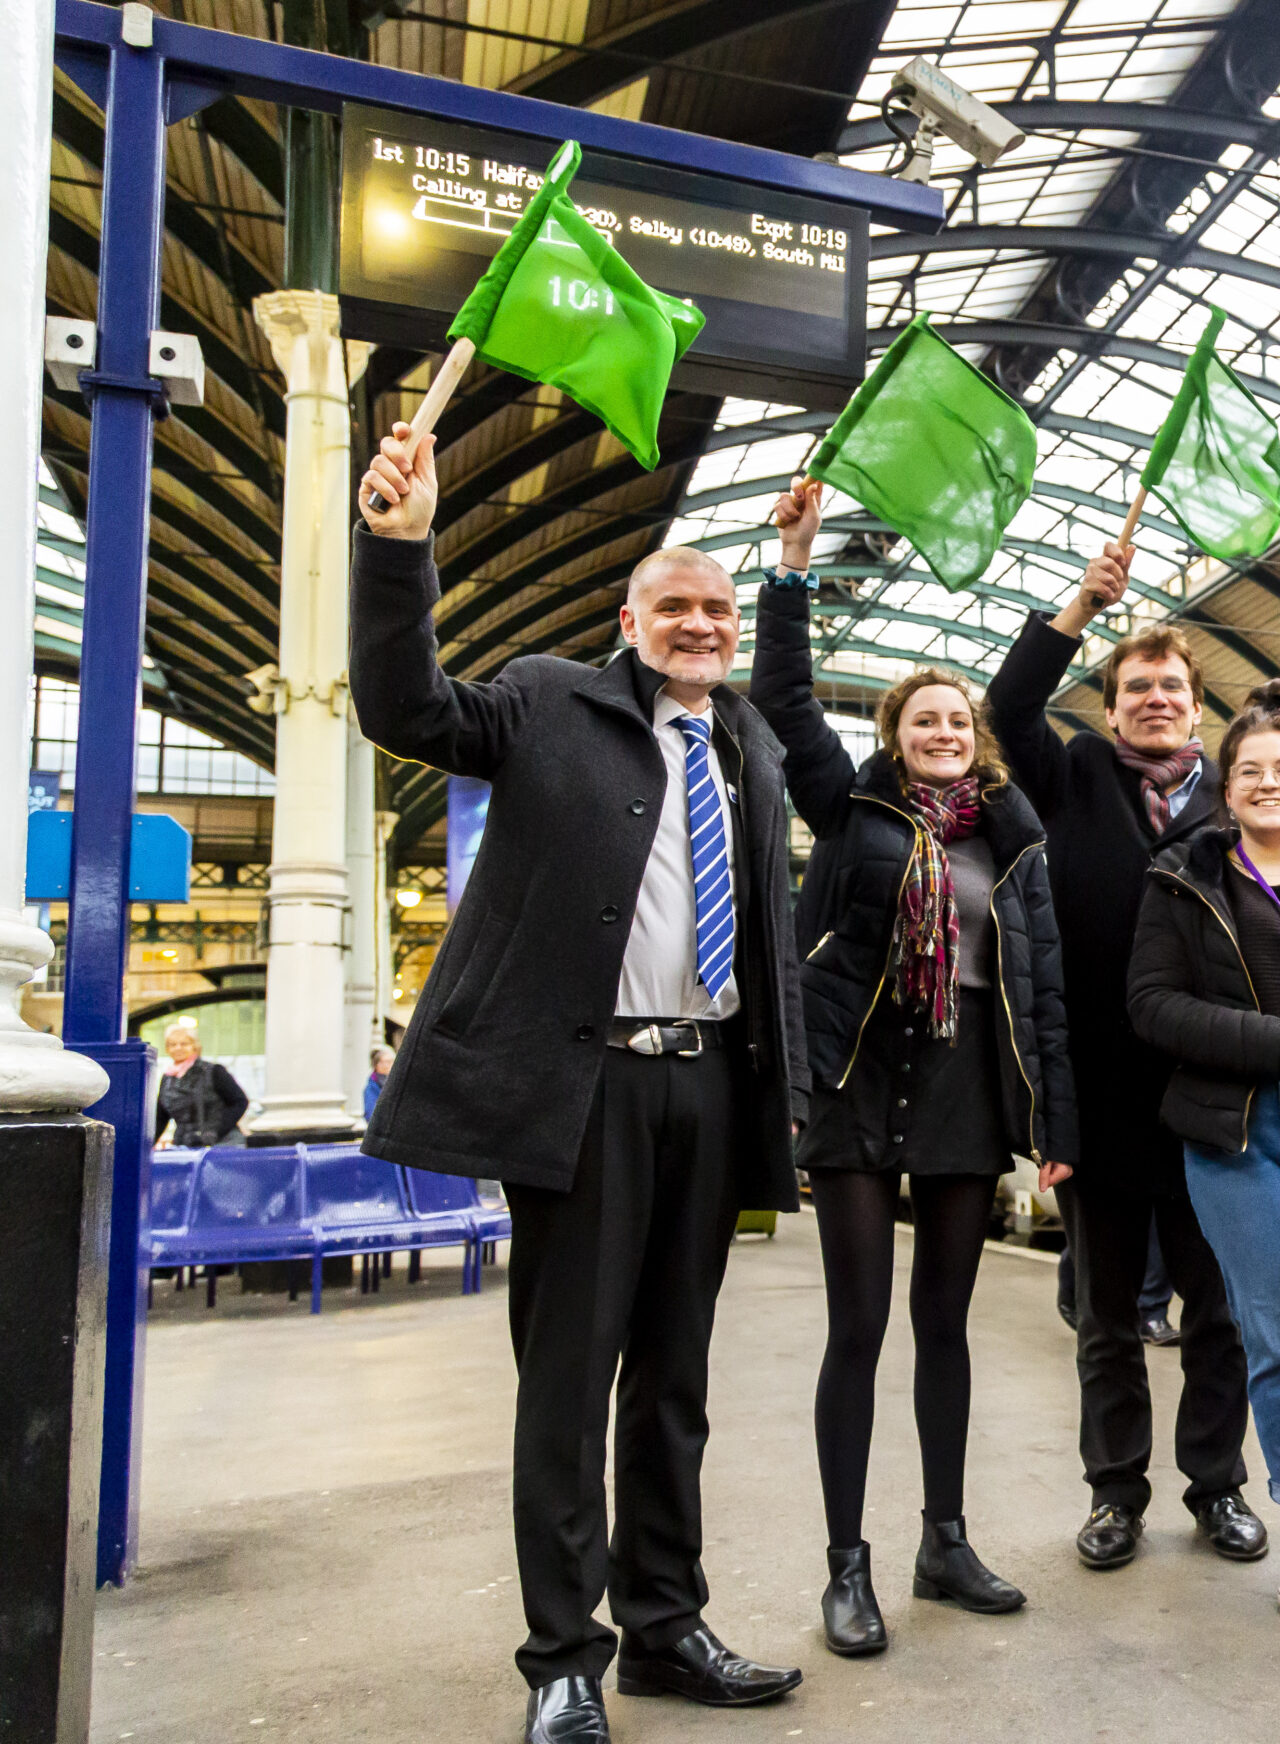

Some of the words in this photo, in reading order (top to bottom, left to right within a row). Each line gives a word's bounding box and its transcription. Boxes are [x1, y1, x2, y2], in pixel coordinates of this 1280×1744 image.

[373, 137, 404, 163] 1st
[415, 146, 470, 176] 10:15
[752, 213, 793, 243] Expt
[801, 224, 847, 251] 10:19
[412, 174, 487, 208] Calling
[495, 192, 522, 210] at:
[629, 216, 683, 246] Selby
[689, 228, 757, 257] (10:49),
[762, 241, 815, 267] South
[820, 253, 847, 273] Mil
